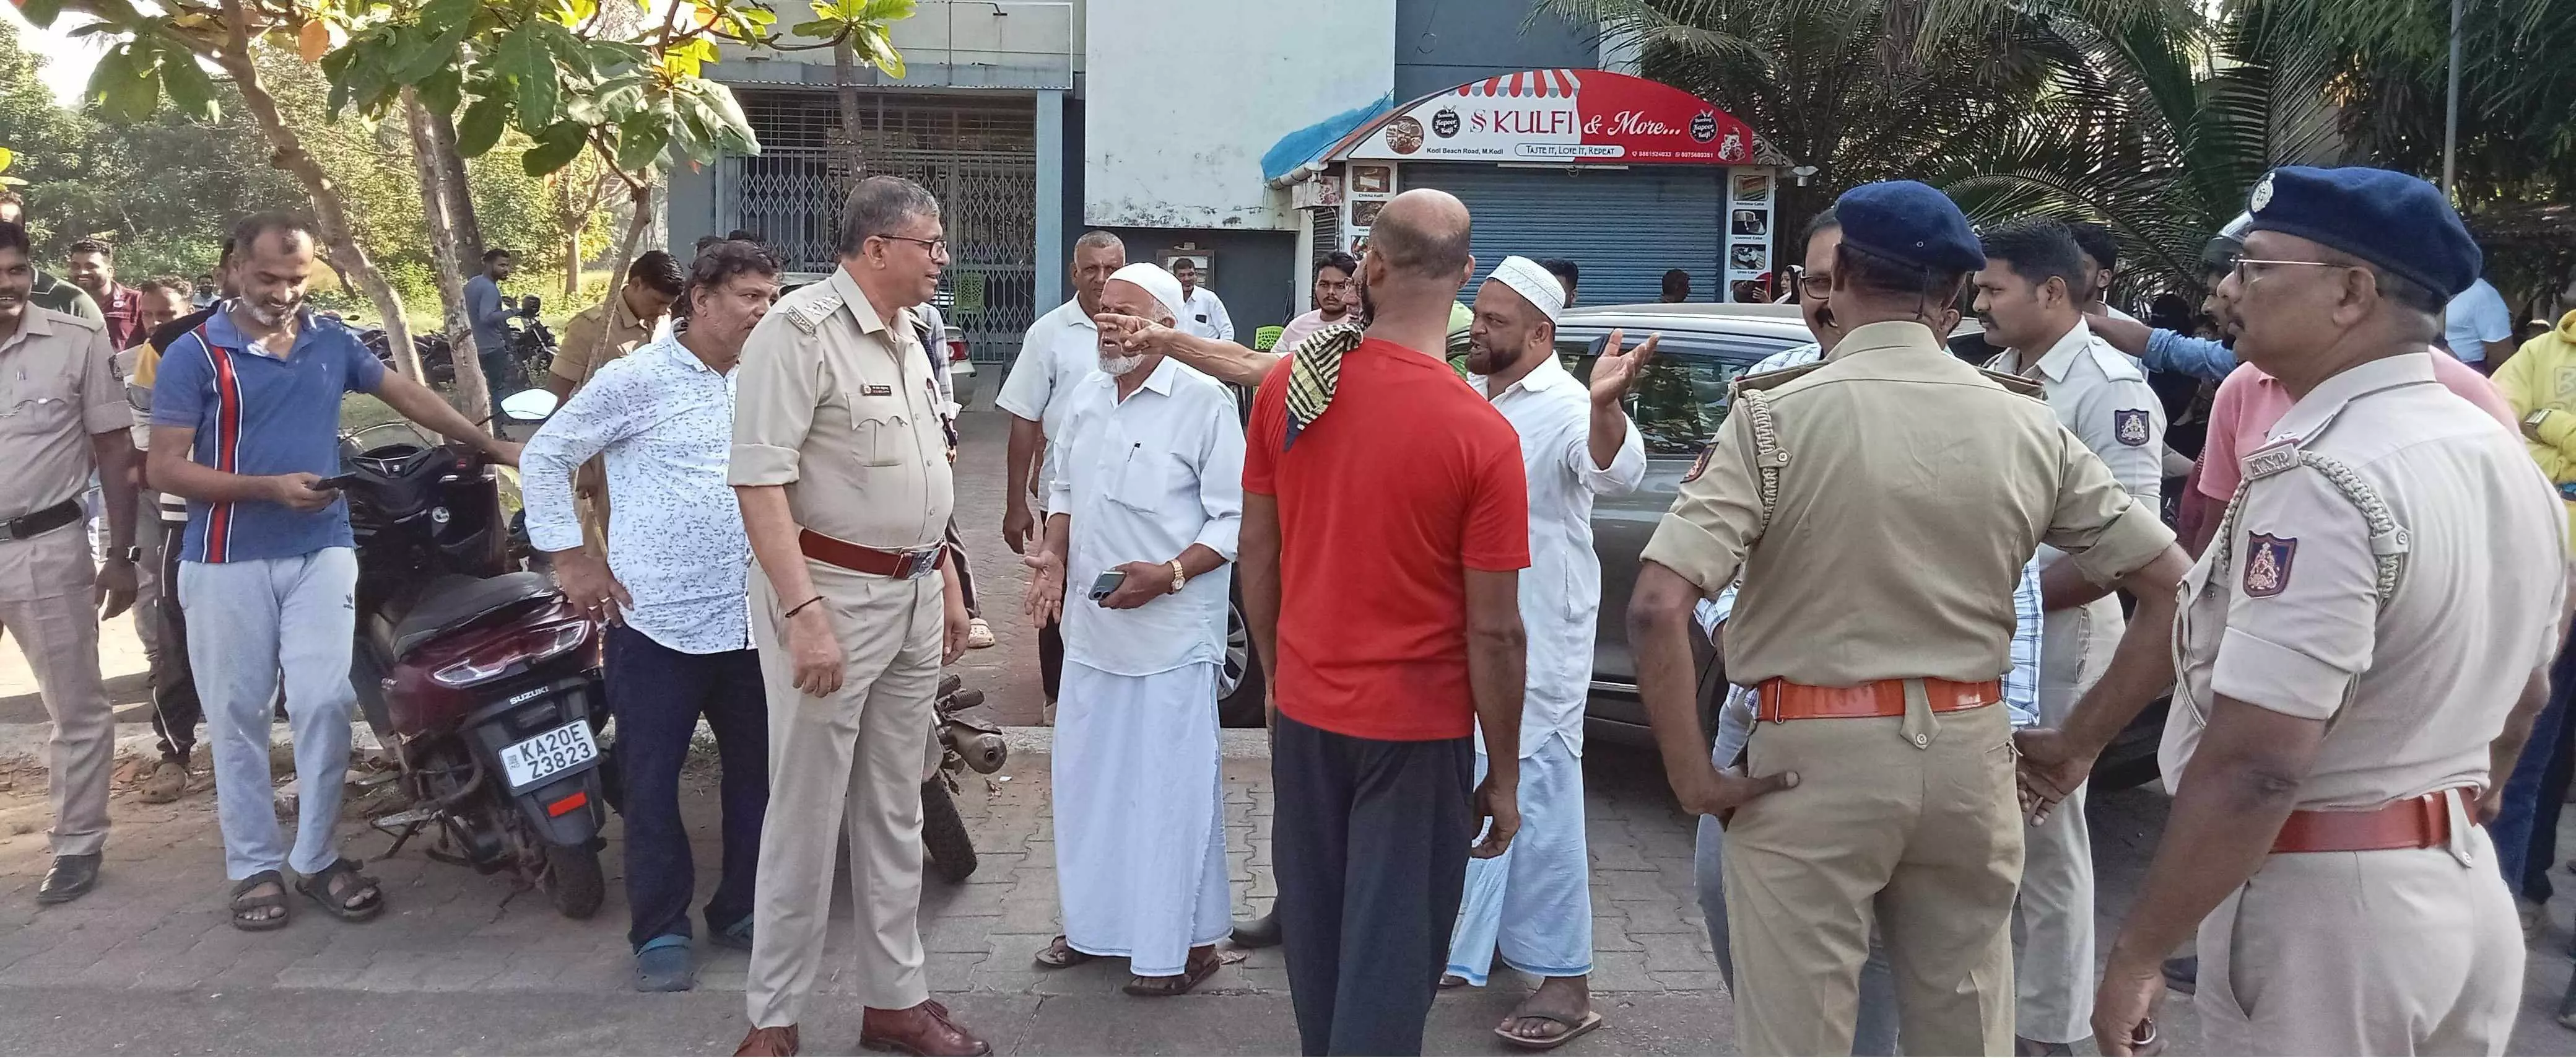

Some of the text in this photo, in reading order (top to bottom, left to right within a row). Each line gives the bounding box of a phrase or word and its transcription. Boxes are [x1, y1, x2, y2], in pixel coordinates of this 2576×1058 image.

[1494, 110, 1573, 134] KULFI
[1583, 115, 1603, 134] &
[1608, 111, 1681, 135] More...
[1526, 146, 1547, 154] TASTE
[1589, 147, 1615, 155] REPEAT
[510, 686, 549, 705] SUZUKI
[520, 724, 584, 762] KA20E
[528, 742, 591, 779] Z3823
